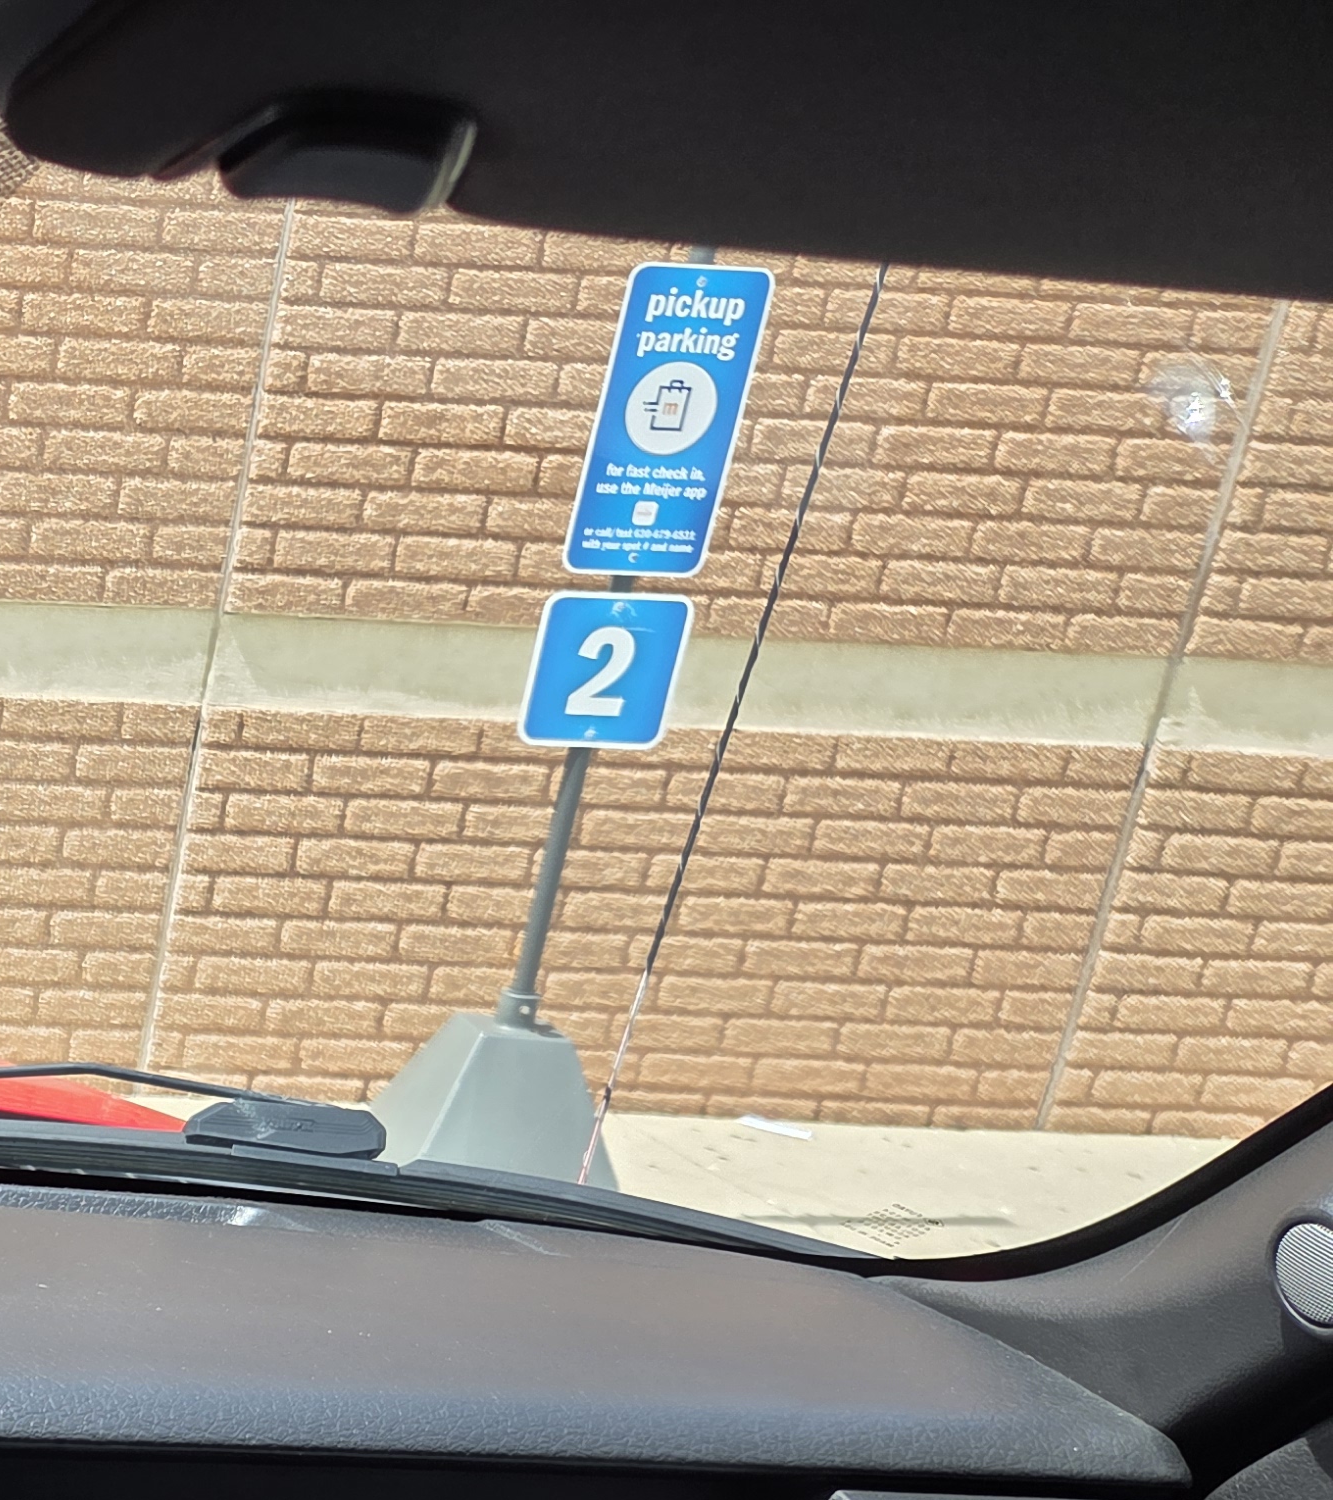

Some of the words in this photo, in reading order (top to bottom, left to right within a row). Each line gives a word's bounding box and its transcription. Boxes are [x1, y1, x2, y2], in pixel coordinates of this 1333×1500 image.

[645, 287, 746, 326] pickup
[636, 327, 740, 361] parking
[606, 462, 625, 477] for
[626, 463, 651, 479] fast
[651, 465, 688, 480] check
[595, 482, 619, 494] use
[620, 481, 641, 495] the
[683, 486, 708, 501] app
[564, 626, 636, 716] 2
